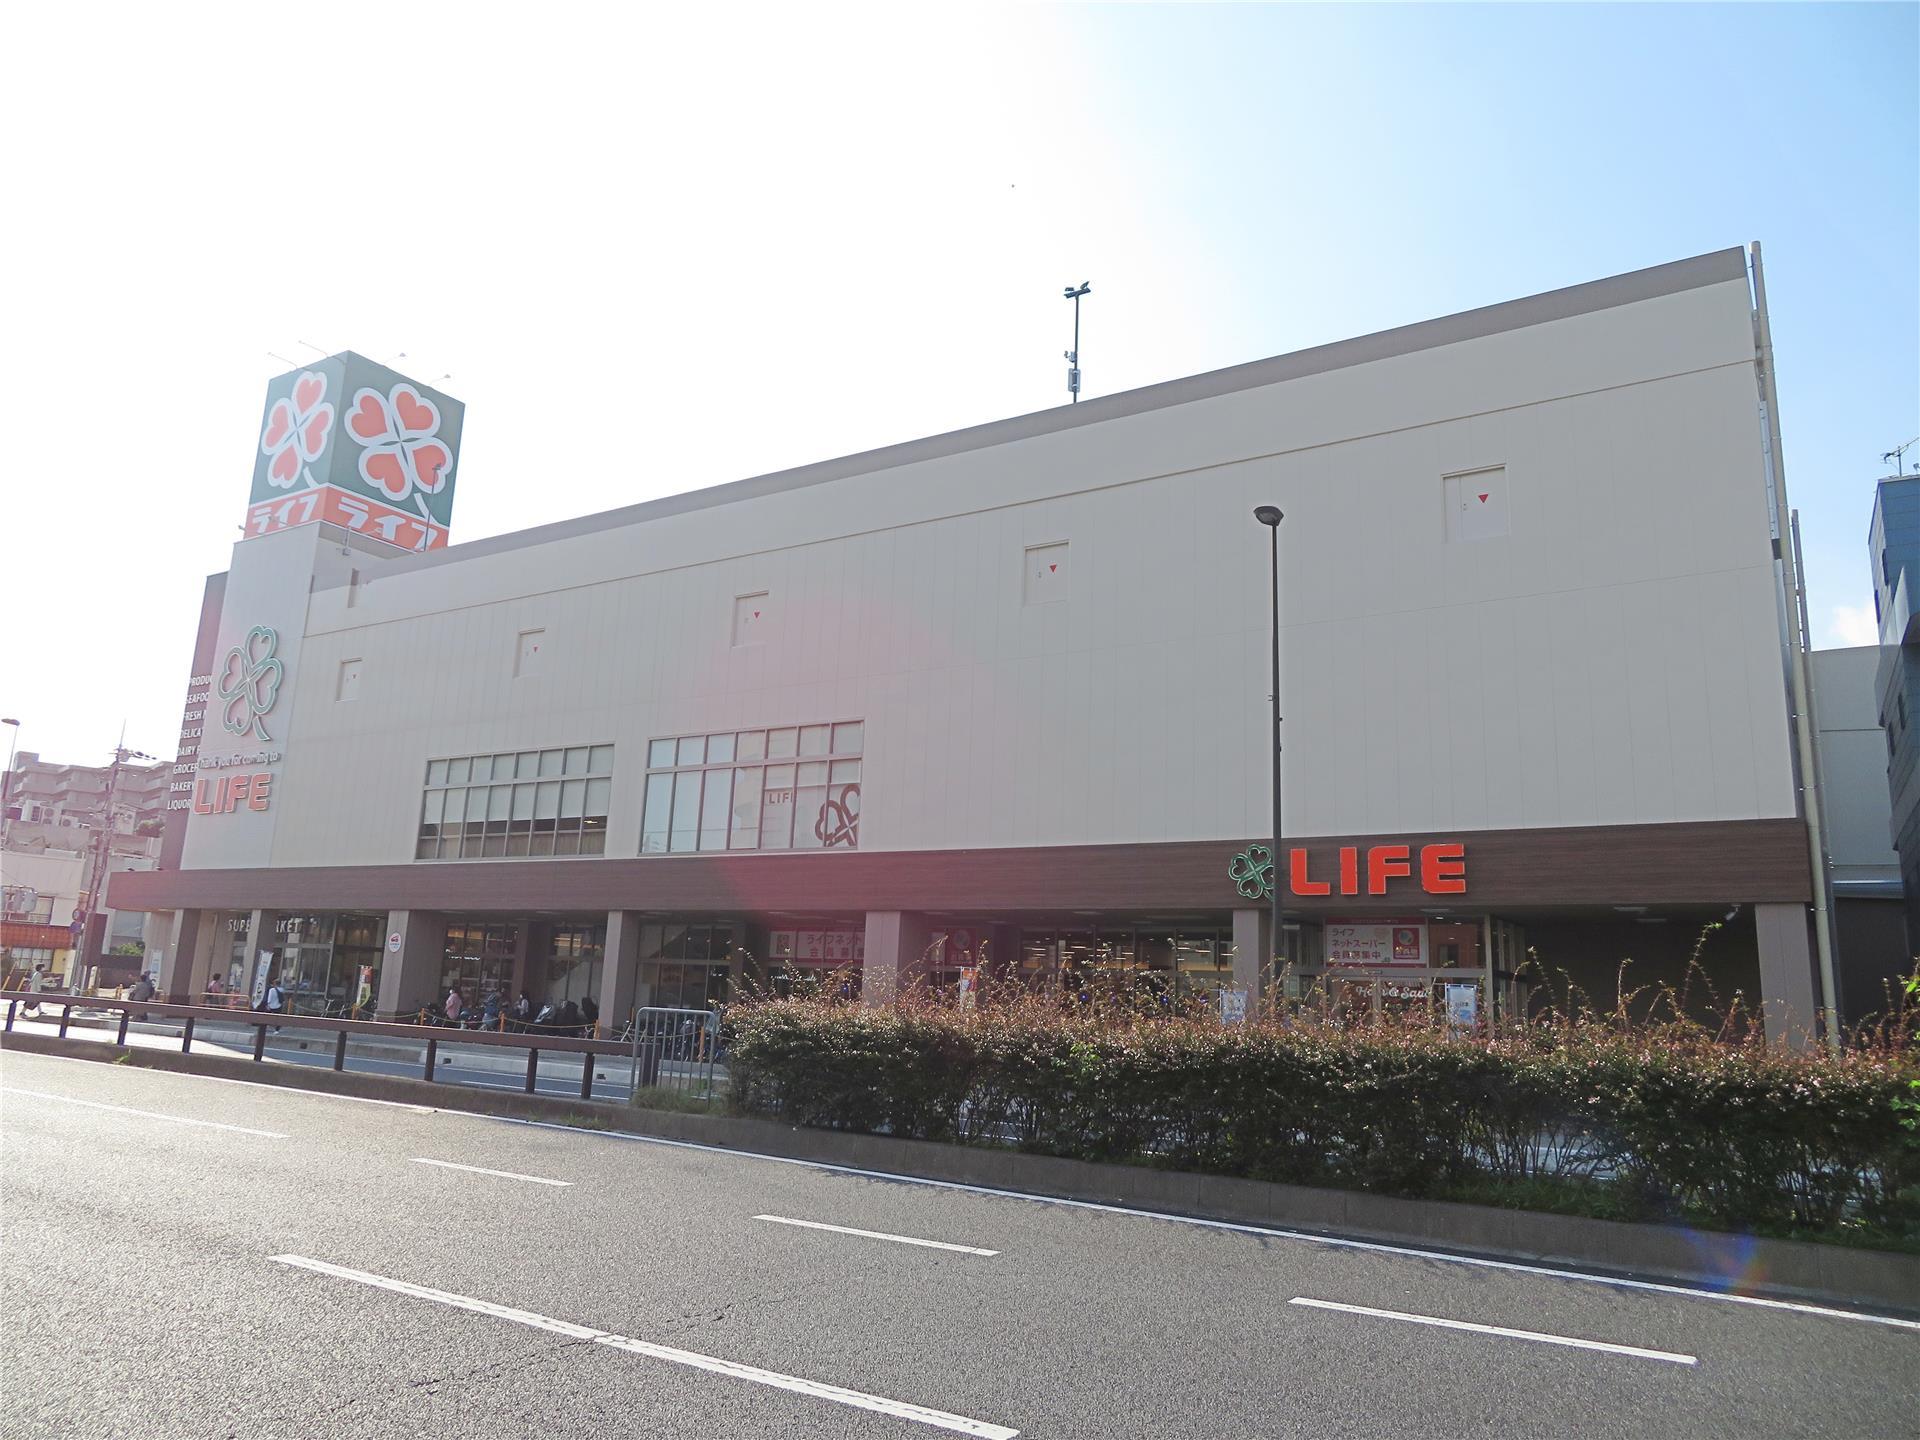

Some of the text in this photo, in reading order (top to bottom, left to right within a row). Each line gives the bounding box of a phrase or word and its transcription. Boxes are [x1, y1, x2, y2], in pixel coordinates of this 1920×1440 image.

[253, 494, 318, 534] ライフ
[338, 496, 438, 551] ライフ
[193, 772, 272, 814] LIFE
[769, 792, 793, 804] LIF
[1290, 843, 1466, 896] LIFE
